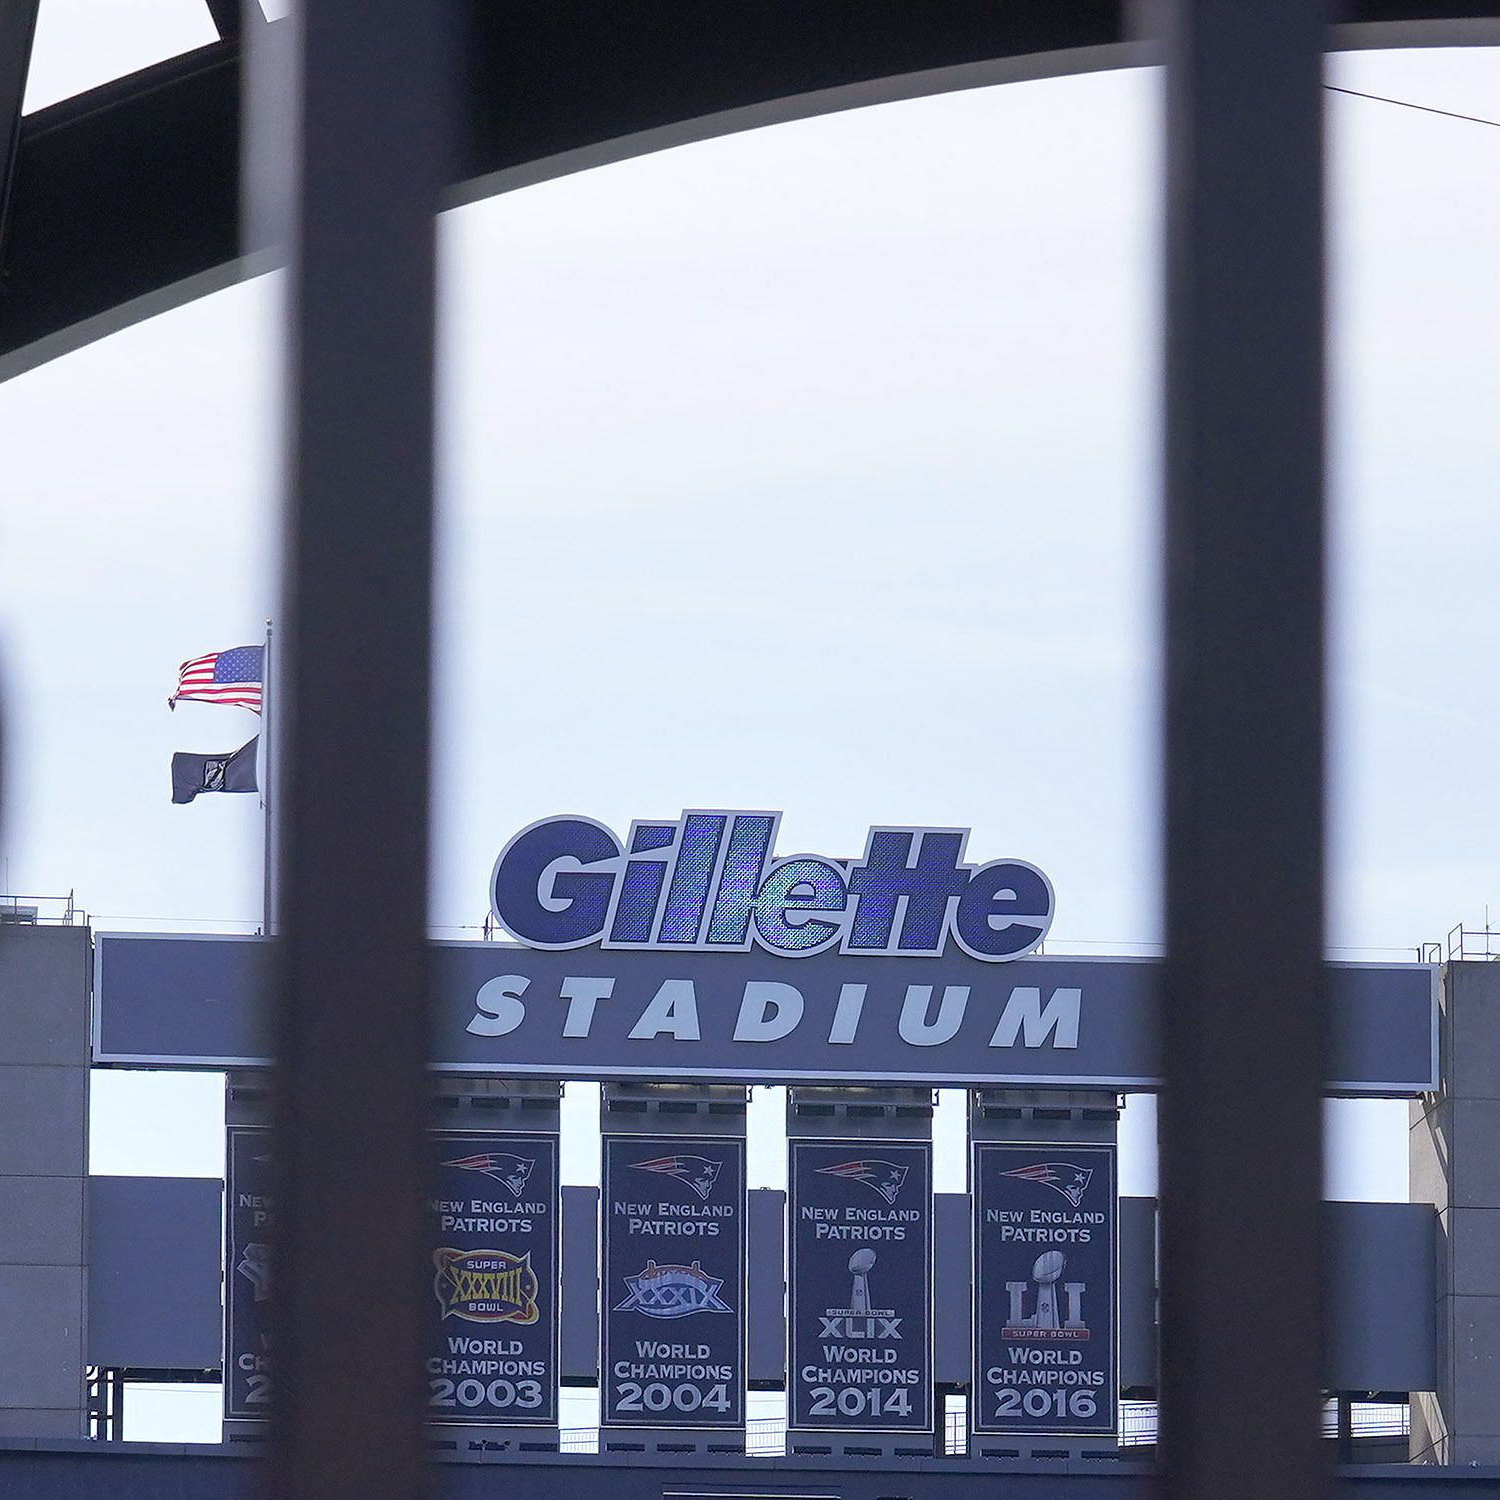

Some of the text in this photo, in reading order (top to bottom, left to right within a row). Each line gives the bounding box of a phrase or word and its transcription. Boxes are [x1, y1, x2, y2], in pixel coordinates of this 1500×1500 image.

[491, 810, 1055, 962] Gillette
[466, 974, 1083, 1050] STADIUM
[471, 1200, 546, 1214] ENGLAND
[614, 1202, 734, 1217] NEW ENGLAND
[802, 1206, 920, 1221] NEW ENGLAND
[441, 1216, 533, 1233] PATRIOTS
[987, 1209, 1105, 1224] NEW ENGLAND
[629, 1218, 720, 1236] PATRIOTS
[816, 1223, 905, 1240] PATRIOTS
[1001, 1226, 1091, 1243] PATRIOTS
[467, 1260, 507, 1270] SUPER
[451, 1267, 523, 1305] XXXVIII
[624, 1283, 724, 1311] XXXIX
[468, 1302, 504, 1312] BOWL
[818, 1317, 903, 1339] XLIX
[1012, 1330, 1047, 1338] SUPER
[448, 1337, 523, 1355] WORLD
[636, 1341, 710, 1359] WORLD
[823, 1345, 898, 1363] WORLD
[1008, 1347, 1083, 1365] WORLD
[427, 1357, 546, 1376] CHAMPIONS
[614, 1361, 732, 1380] CHAMPIONS
[802, 1366, 920, 1385] CHAMPIONS
[987, 1367, 1104, 1385] CHAMPIONS
[429, 1379, 542, 1409] 2003
[616, 1382, 731, 1412] 2004
[809, 1387, 913, 1417] 2014
[995, 1388, 1097, 1418] 2016
